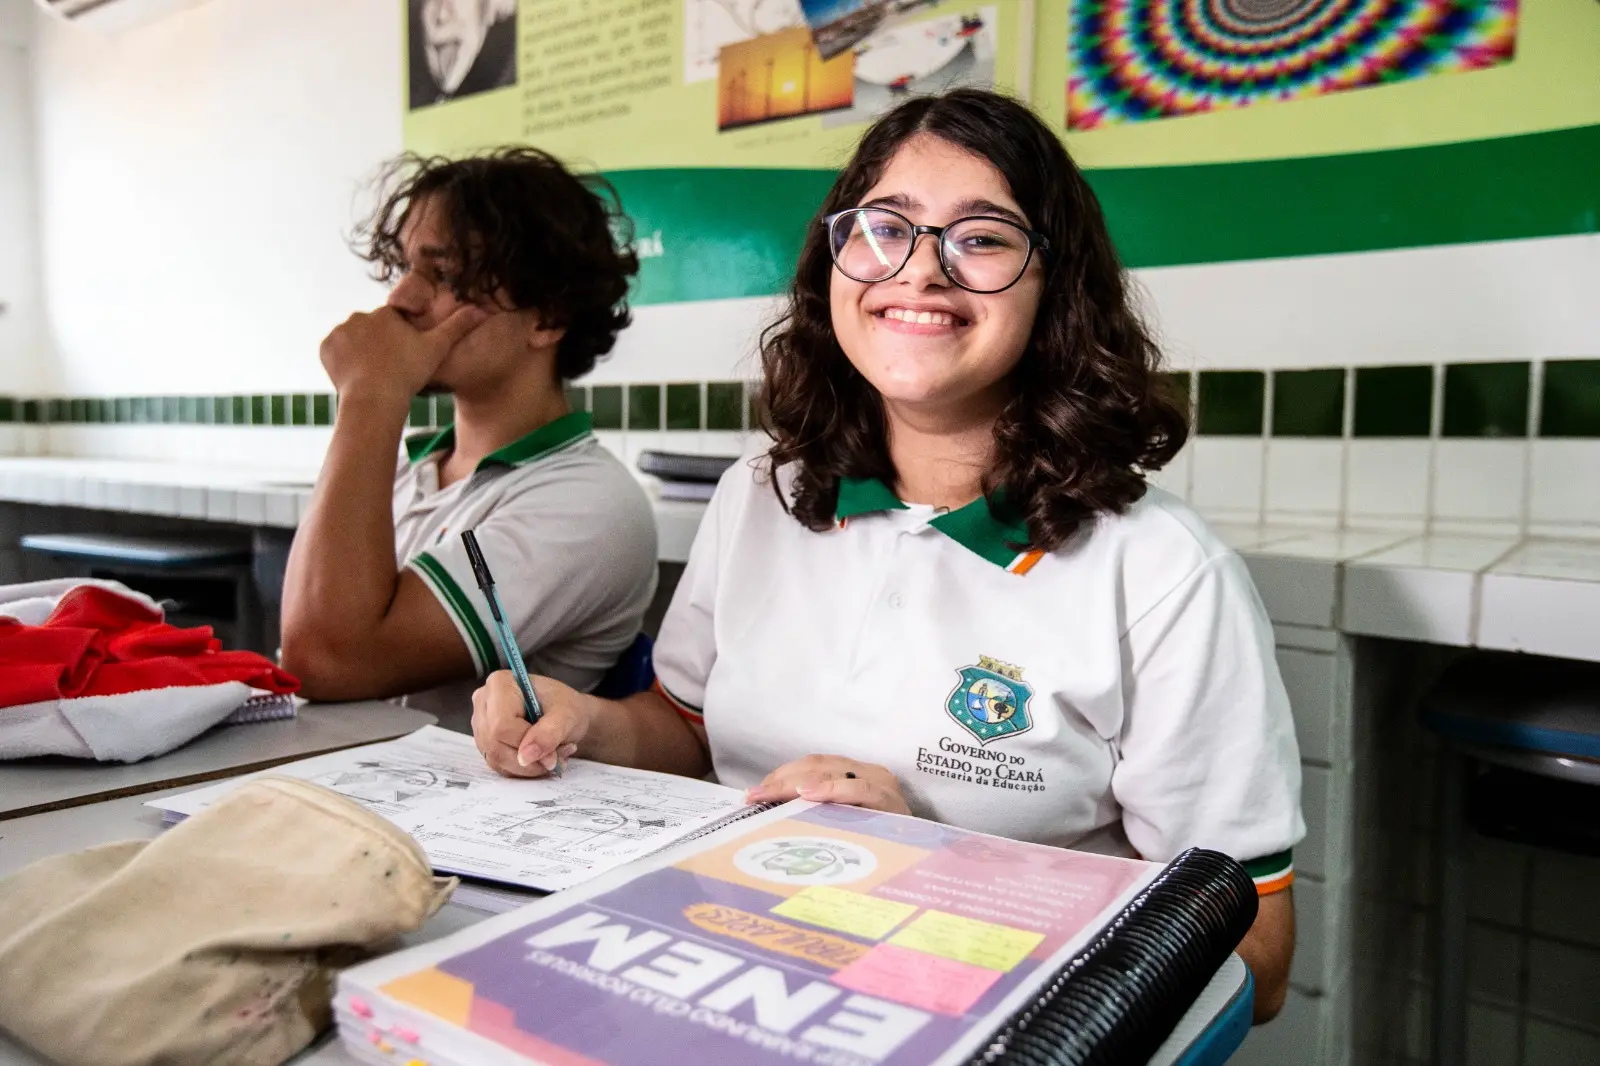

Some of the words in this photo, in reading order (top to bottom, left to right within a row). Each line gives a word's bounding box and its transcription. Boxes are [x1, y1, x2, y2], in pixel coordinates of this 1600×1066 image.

[916, 747, 972, 772] ESTADO
[975, 766, 992, 777] DO
[996, 764, 1043, 782] CEARÁ
[939, 737, 1006, 762] GOVERNO
[916, 763, 972, 782] Secretaria
[976, 776, 988, 786] da
[993, 778, 1045, 793] Educação
[524, 911, 932, 1063] ENEM
